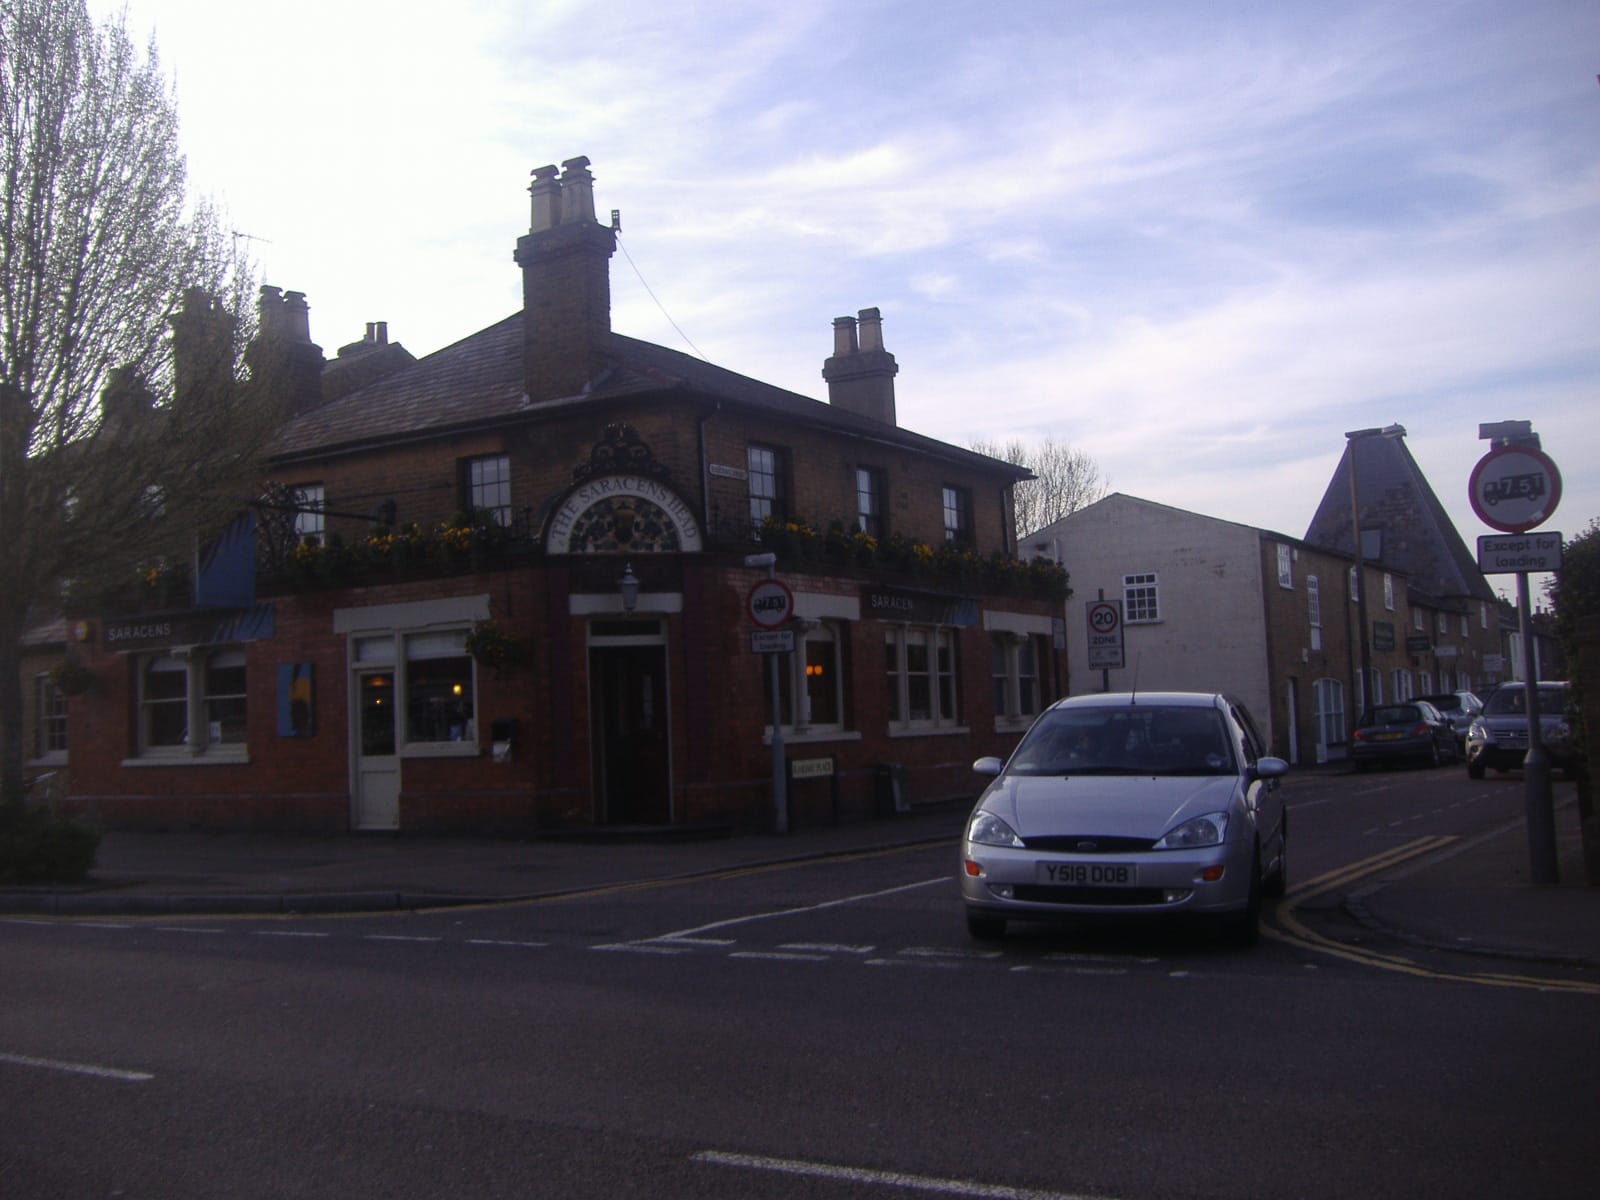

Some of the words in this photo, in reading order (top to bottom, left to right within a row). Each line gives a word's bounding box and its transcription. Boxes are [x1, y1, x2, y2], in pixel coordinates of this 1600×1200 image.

[552, 500, 581, 539] THE
[579, 477, 668, 504] SARACENS
[667, 498, 698, 539] HEAD
[1484, 540, 1530, 553] Except
[1536, 538, 1556, 550] for
[1496, 556, 1546, 568] loading
[1095, 612, 1114, 625] 20
[108, 623, 171, 641] SARACENS
[1093, 635, 1117, 645] ZONE
[1047, 864, 1087, 882] Y518
